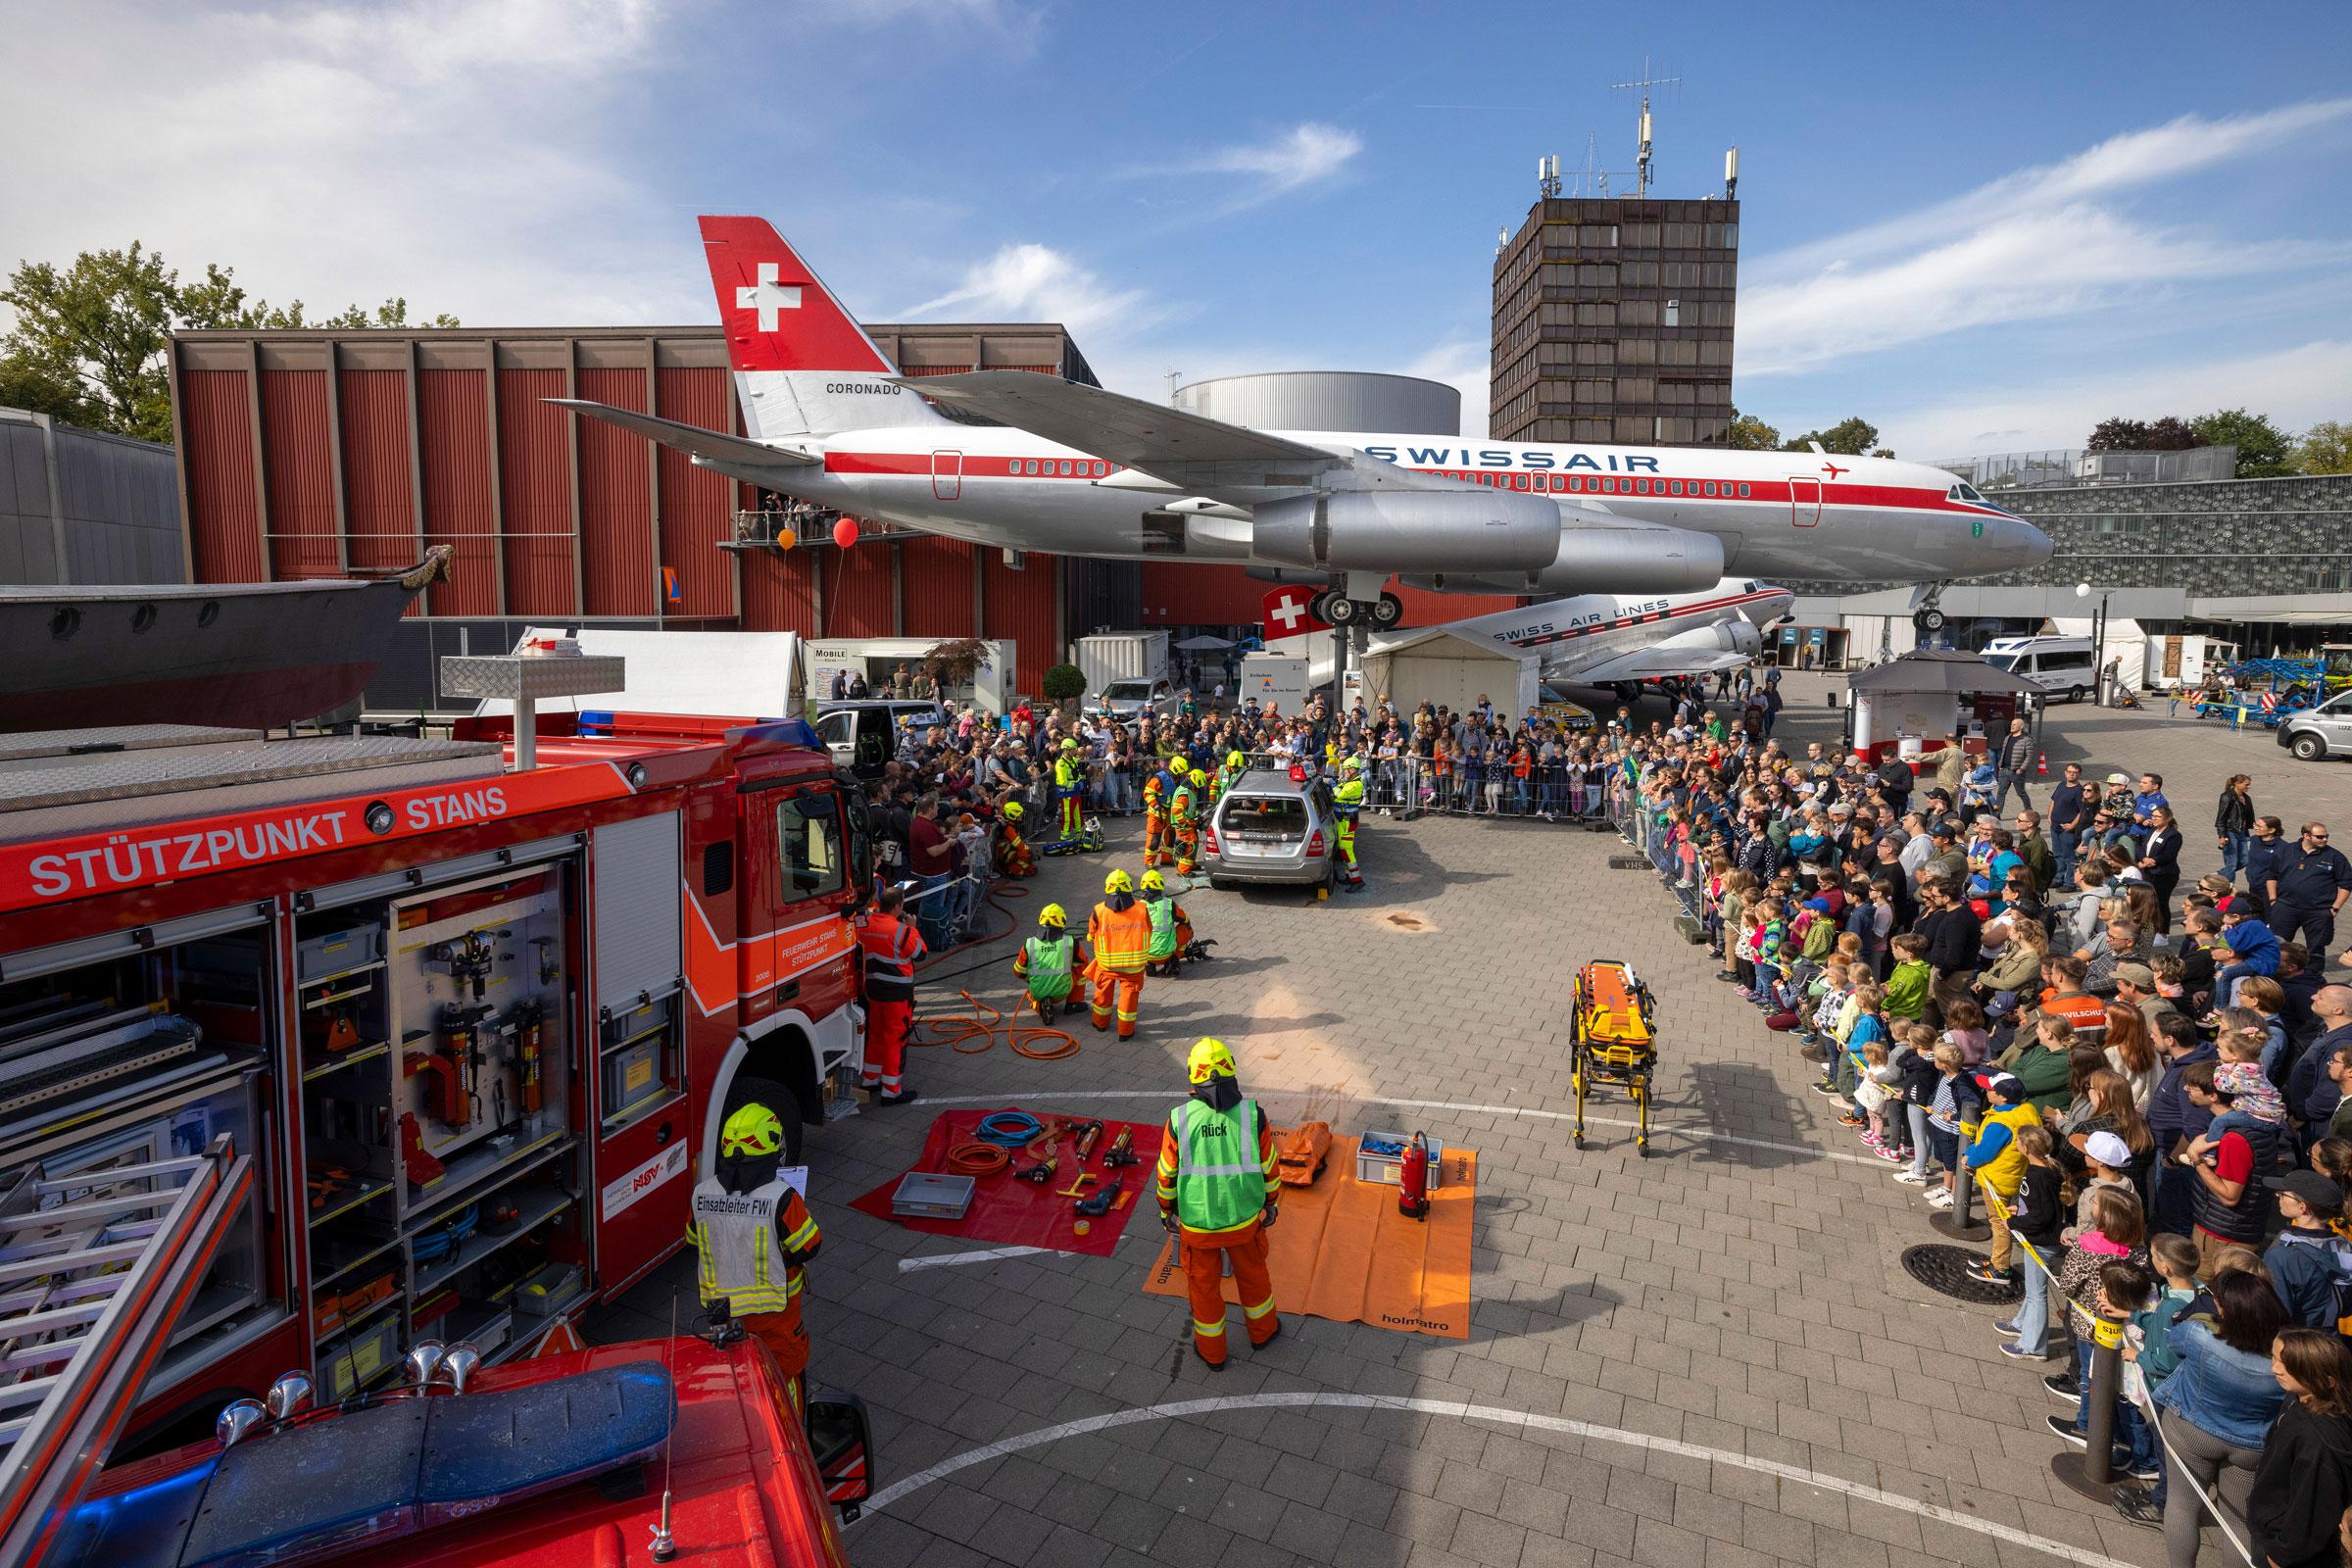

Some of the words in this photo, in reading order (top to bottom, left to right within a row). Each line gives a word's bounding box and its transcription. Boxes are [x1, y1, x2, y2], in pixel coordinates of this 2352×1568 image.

[826, 383, 902, 396] CORONADO
[1364, 446, 1661, 473] SWISSAIR
[1493, 622, 1554, 642] SWISS
[1570, 612, 1601, 628] AIR
[1613, 599, 1670, 618] LINES
[29, 810, 348, 897] STÜTZPUNKT
[406, 787, 508, 831] STANS
[1625, 860, 1644, 870] VHS
[782, 936, 818, 958] FEUERWEHR
[819, 928, 837, 944] STANS
[1041, 944, 1057, 954] Front
[791, 944, 828, 966] STÜTZPUNKT
[2059, 1008, 2105, 1019] IVILSCHUT
[1200, 1122, 1228, 1138] Rück
[632, 1162, 661, 1193] NSV
[697, 1196, 751, 1215] Einsatzleiter
[752, 1199, 769, 1216] FW
[1382, 1313, 1449, 1331] holmatro
